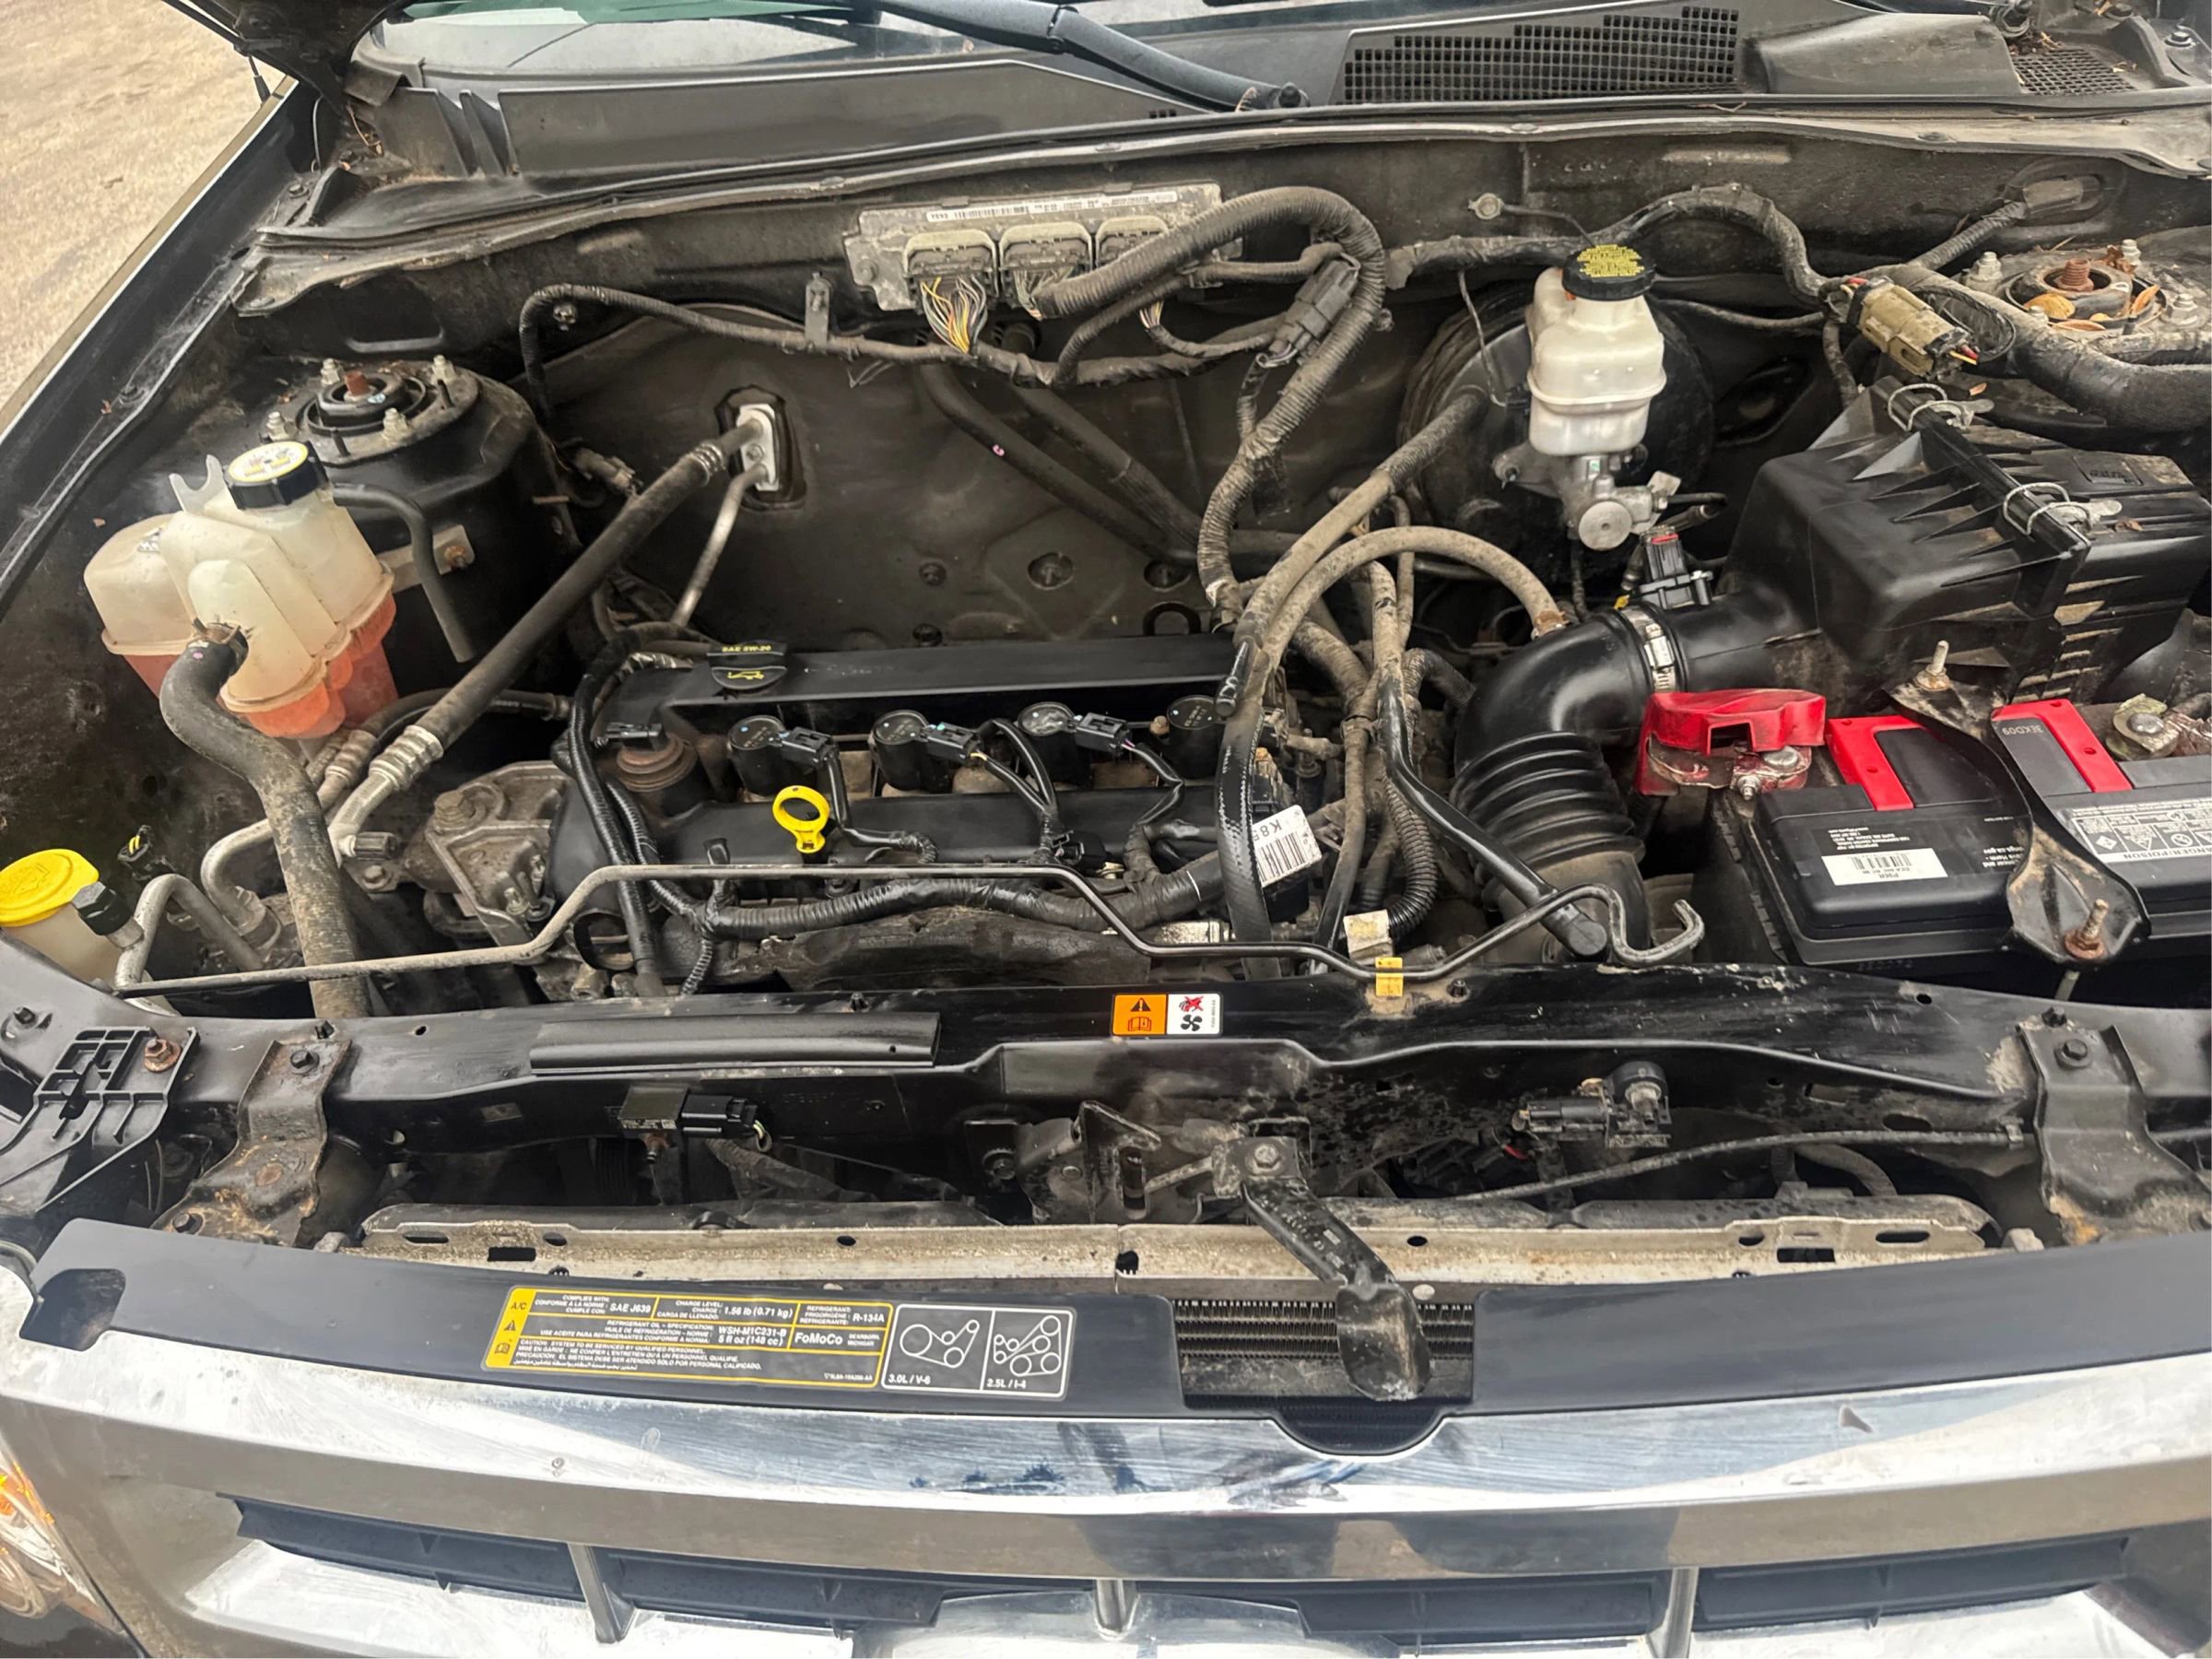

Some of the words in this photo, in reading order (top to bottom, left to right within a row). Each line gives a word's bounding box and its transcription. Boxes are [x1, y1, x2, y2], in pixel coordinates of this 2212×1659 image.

[2001, 724, 2043, 735] 3EKD09
[2123, 847, 2212, 859] ANGER/POISON
[510, 1301, 527, 1310] A/C
[610, 1303, 628, 1312] SAE
[630, 1304, 651, 1313] J639
[743, 1307, 751, 1316] lb
[753, 1306, 775, 1317] (0.71
[777, 1308, 793, 1319] kg)
[852, 1313, 884, 1323] R-134A
[718, 1326, 787, 1337] WSH-M1C231-B
[726, 1335, 732, 1343] fl
[746, 1335, 765, 1345] (148
[768, 1336, 783, 1346] cc)
[794, 1332, 843, 1345] FoMoCo
[888, 1373, 908, 1383] 3.0L
[916, 1376, 931, 1385] V-6
[987, 1379, 1006, 1388] 2.5L
[1014, 1380, 1026, 1389] I-4
